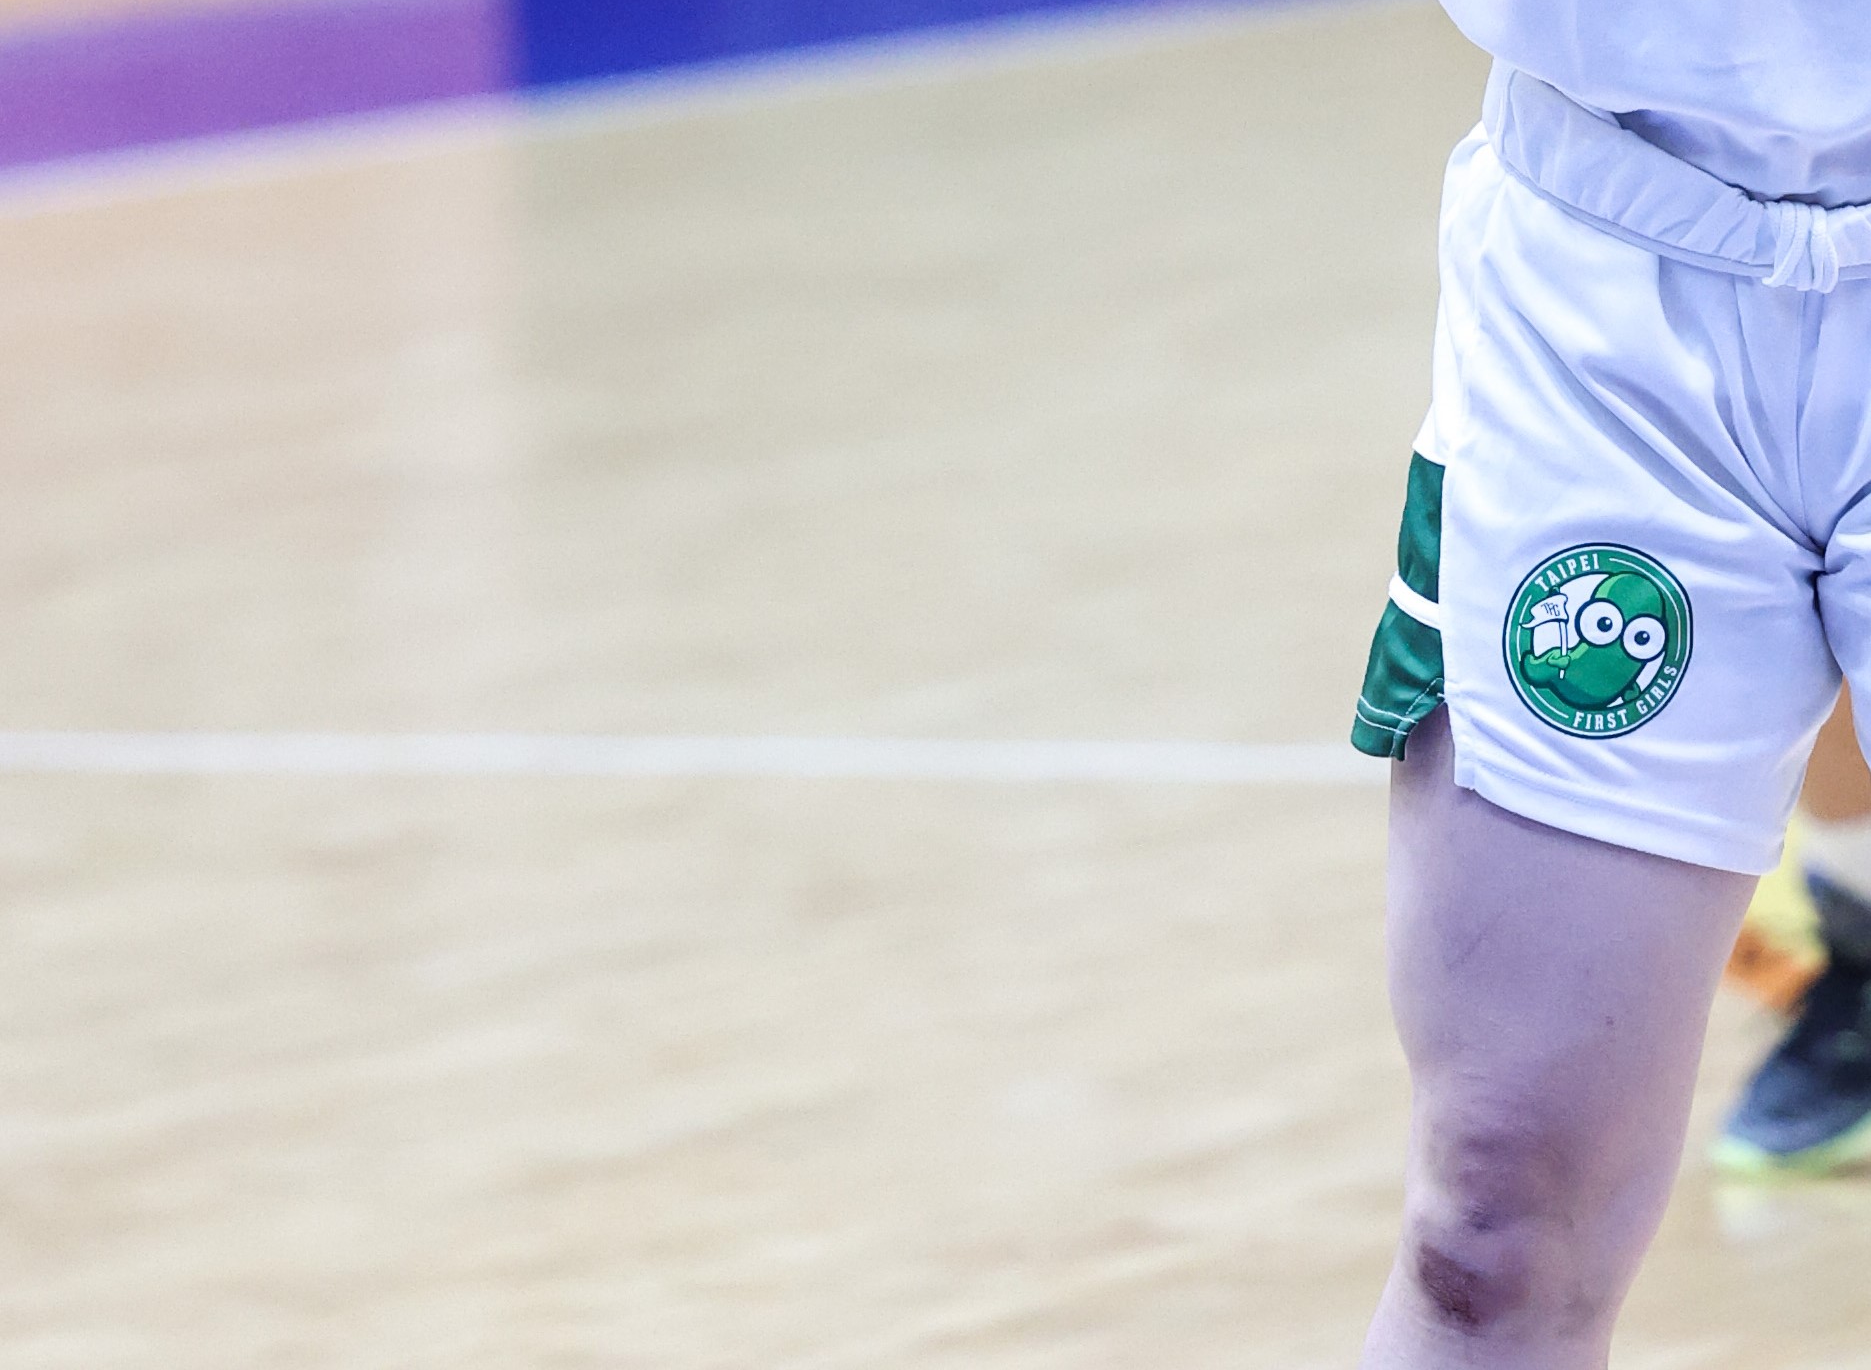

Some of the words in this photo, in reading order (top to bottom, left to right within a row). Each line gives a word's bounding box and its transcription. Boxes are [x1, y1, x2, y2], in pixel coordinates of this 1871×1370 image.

[1535, 553, 1600, 592] TAIPEI
[1573, 709, 1629, 730] FIRST
[1636, 665, 1677, 715] GIRLS
